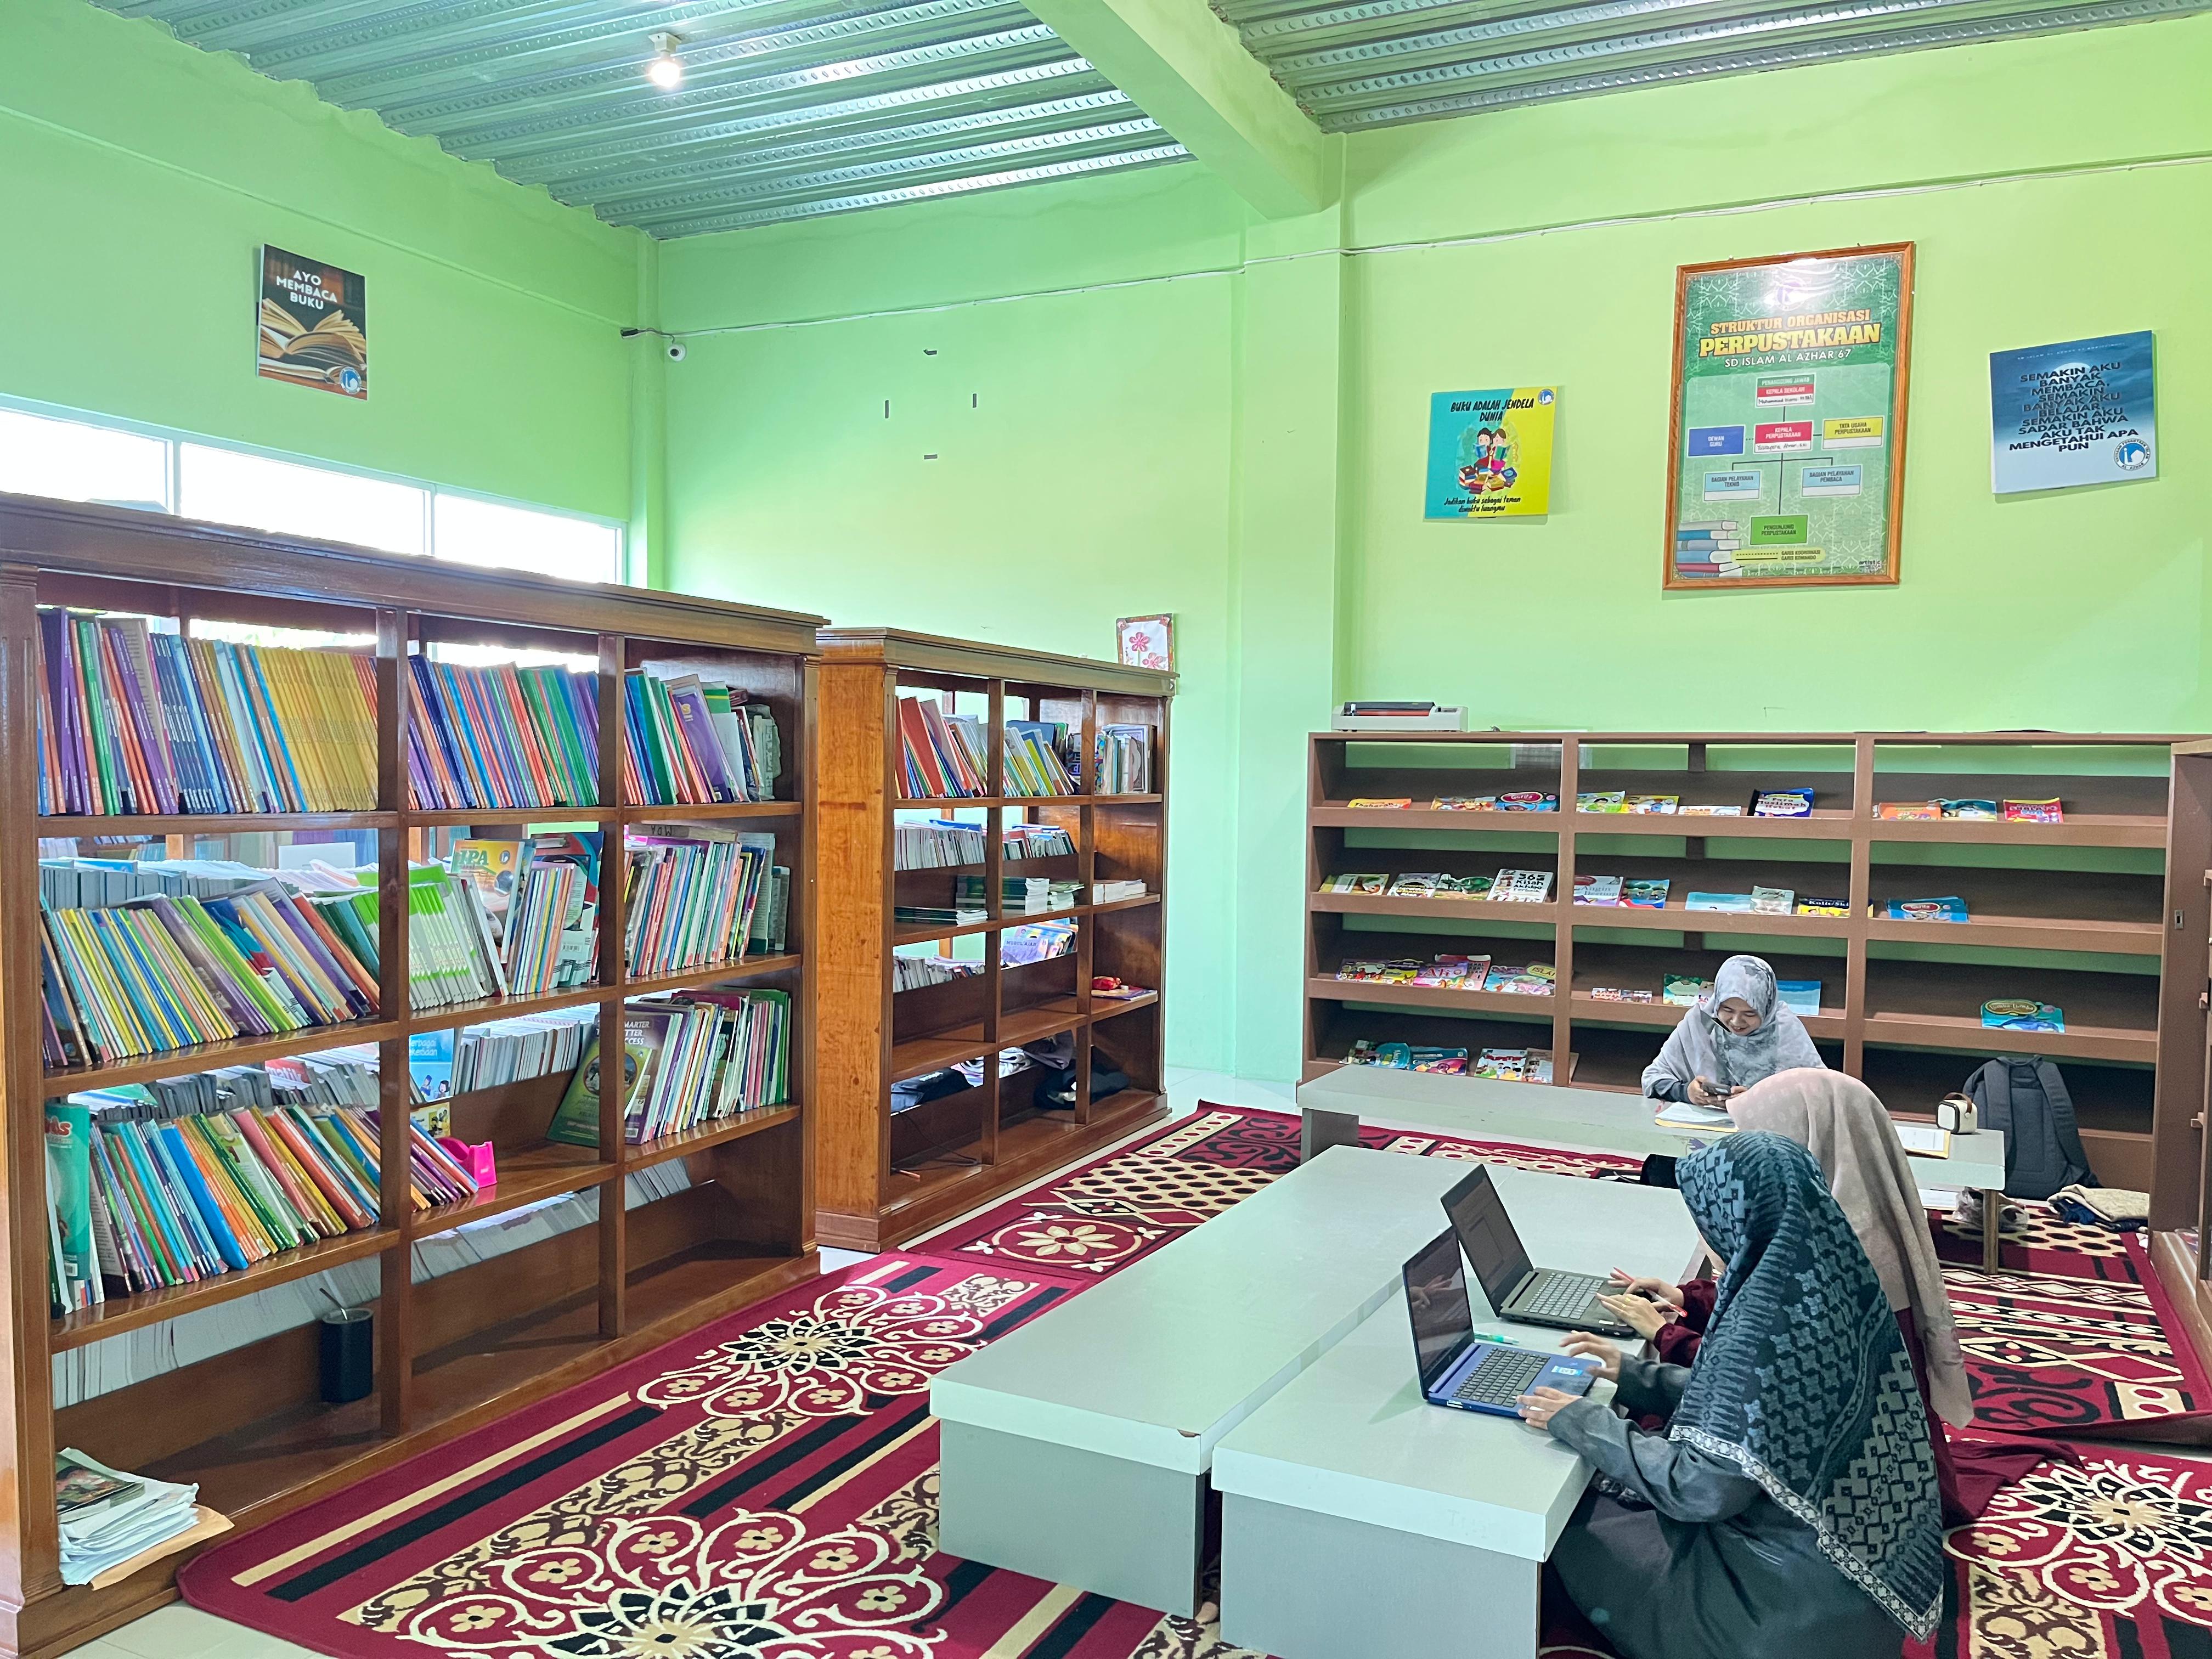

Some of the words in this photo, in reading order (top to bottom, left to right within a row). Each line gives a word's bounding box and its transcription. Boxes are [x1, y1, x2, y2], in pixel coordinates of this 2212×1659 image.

[293, 270, 321, 285] AYO
[276, 276, 337, 303] MEMBACA
[290, 292, 324, 309] BUKU
[1711, 317, 1782, 334] STRUKTUR
[1787, 309, 1870, 328] ORGANISASI
[1699, 323, 1881, 357] PERPUSTAKAAN
[1724, 358, 1738, 368] SD
[1742, 355, 1775, 366] ISLAM
[1779, 353, 1792, 363] AL
[1796, 351, 1834, 362] AZHAR
[1838, 349, 1851, 358] 67
[2021, 367, 2085, 382] SEMAKIN
[2089, 362, 2120, 373] AKU
[2039, 372, 2101, 387] BANYAK
[2032, 380, 2109, 396] MEMBACA,
[2039, 387, 2104, 402] SEMAKIN
[1451, 402, 1470, 412] BUKU
[1472, 400, 1501, 411] ADALAH
[1502, 398, 1534, 410] JENDELA
[2023, 398, 2084, 413] BANYAK
[2090, 392, 2120, 404] AKU
[1480, 411, 1503, 422] DUNIA
[2022, 412, 2087, 427] SEMAKIN
[2092, 407, 2123, 417] AKU
[2018, 422, 2066, 435] SADAR
[2072, 415, 2128, 428] BAHWA
[2040, 430, 2072, 439] AKU
[2076, 425, 2106, 435] TAK
[2009, 433, 2104, 450] MENGETAHUI
[2107, 429, 2138, 439] APA
[2058, 442, 2089, 452] PUN
[1444, 498, 1465, 506] Jadikan
[1481, 496, 1502, 505] sebagai
[459, 850, 489, 865] IPA
[1519, 873, 1545, 881] 365
